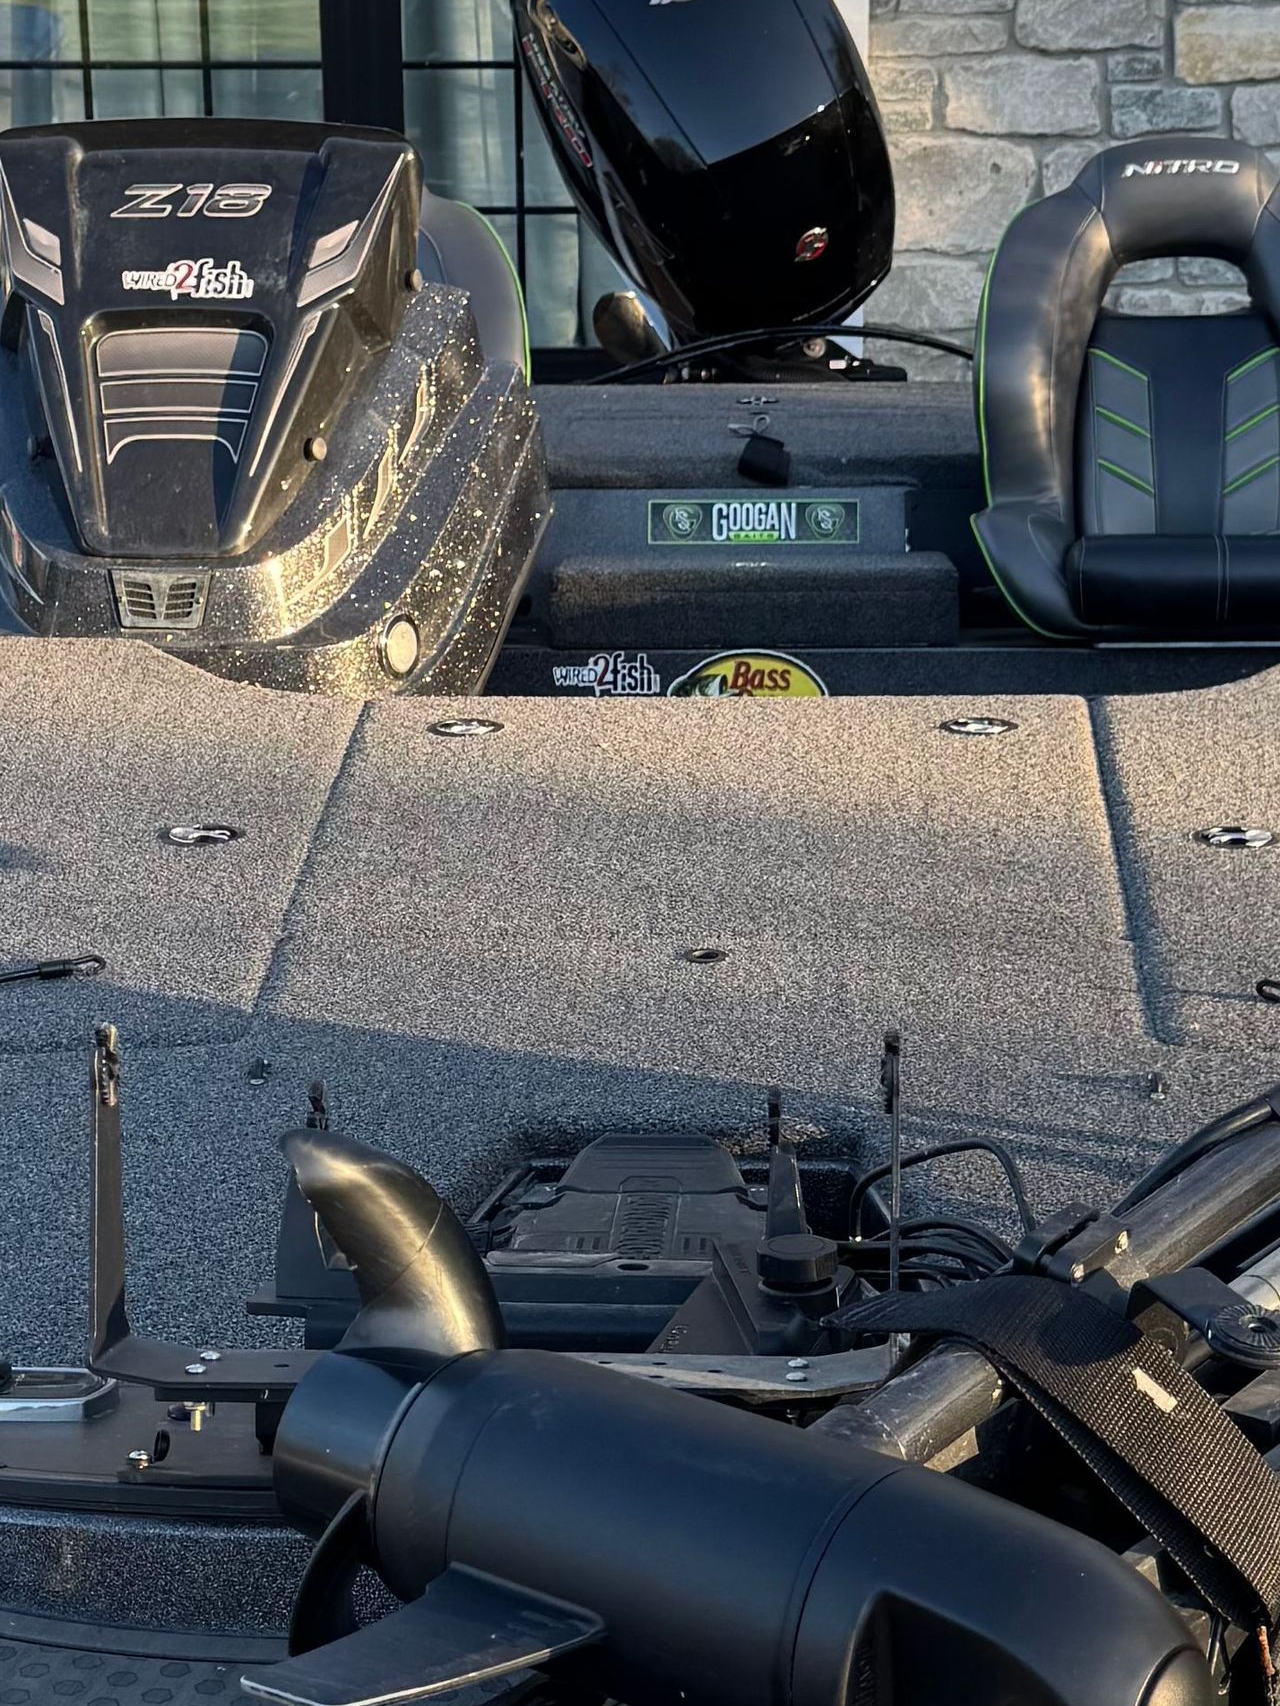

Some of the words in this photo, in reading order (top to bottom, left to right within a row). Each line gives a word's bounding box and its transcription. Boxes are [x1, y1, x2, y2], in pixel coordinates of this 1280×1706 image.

[1121, 158, 1241, 179] NITRO
[109, 183, 273, 218] Z18
[711, 502, 797, 541] GOOGAN
[730, 660, 791, 690] Bass
